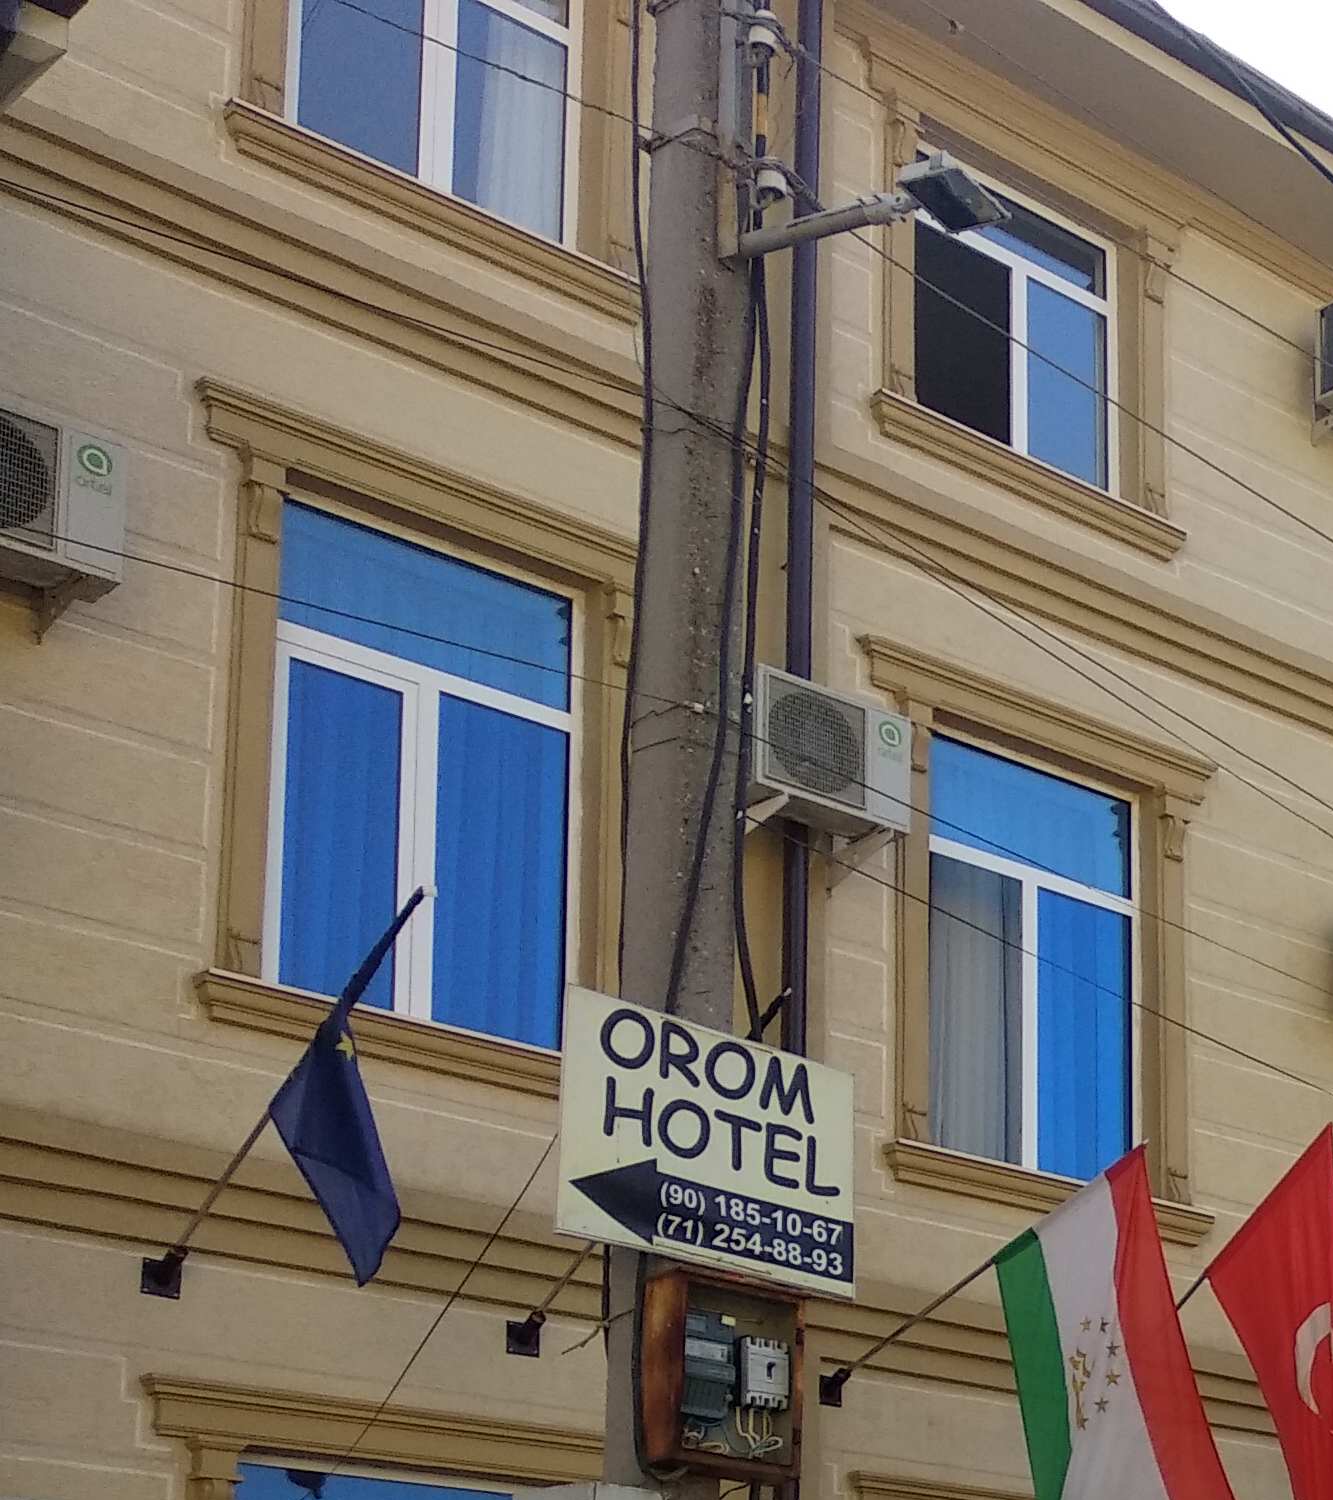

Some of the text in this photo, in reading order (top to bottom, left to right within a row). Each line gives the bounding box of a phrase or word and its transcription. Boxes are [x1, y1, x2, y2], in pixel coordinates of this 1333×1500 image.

[600, 1009, 816, 1125] OROM
[603, 1076, 841, 1197] HOTEL
[657, 1212, 844, 1276] (71) 254-88-93
[660, 1182, 844, 1246] (90) 185-10-67
